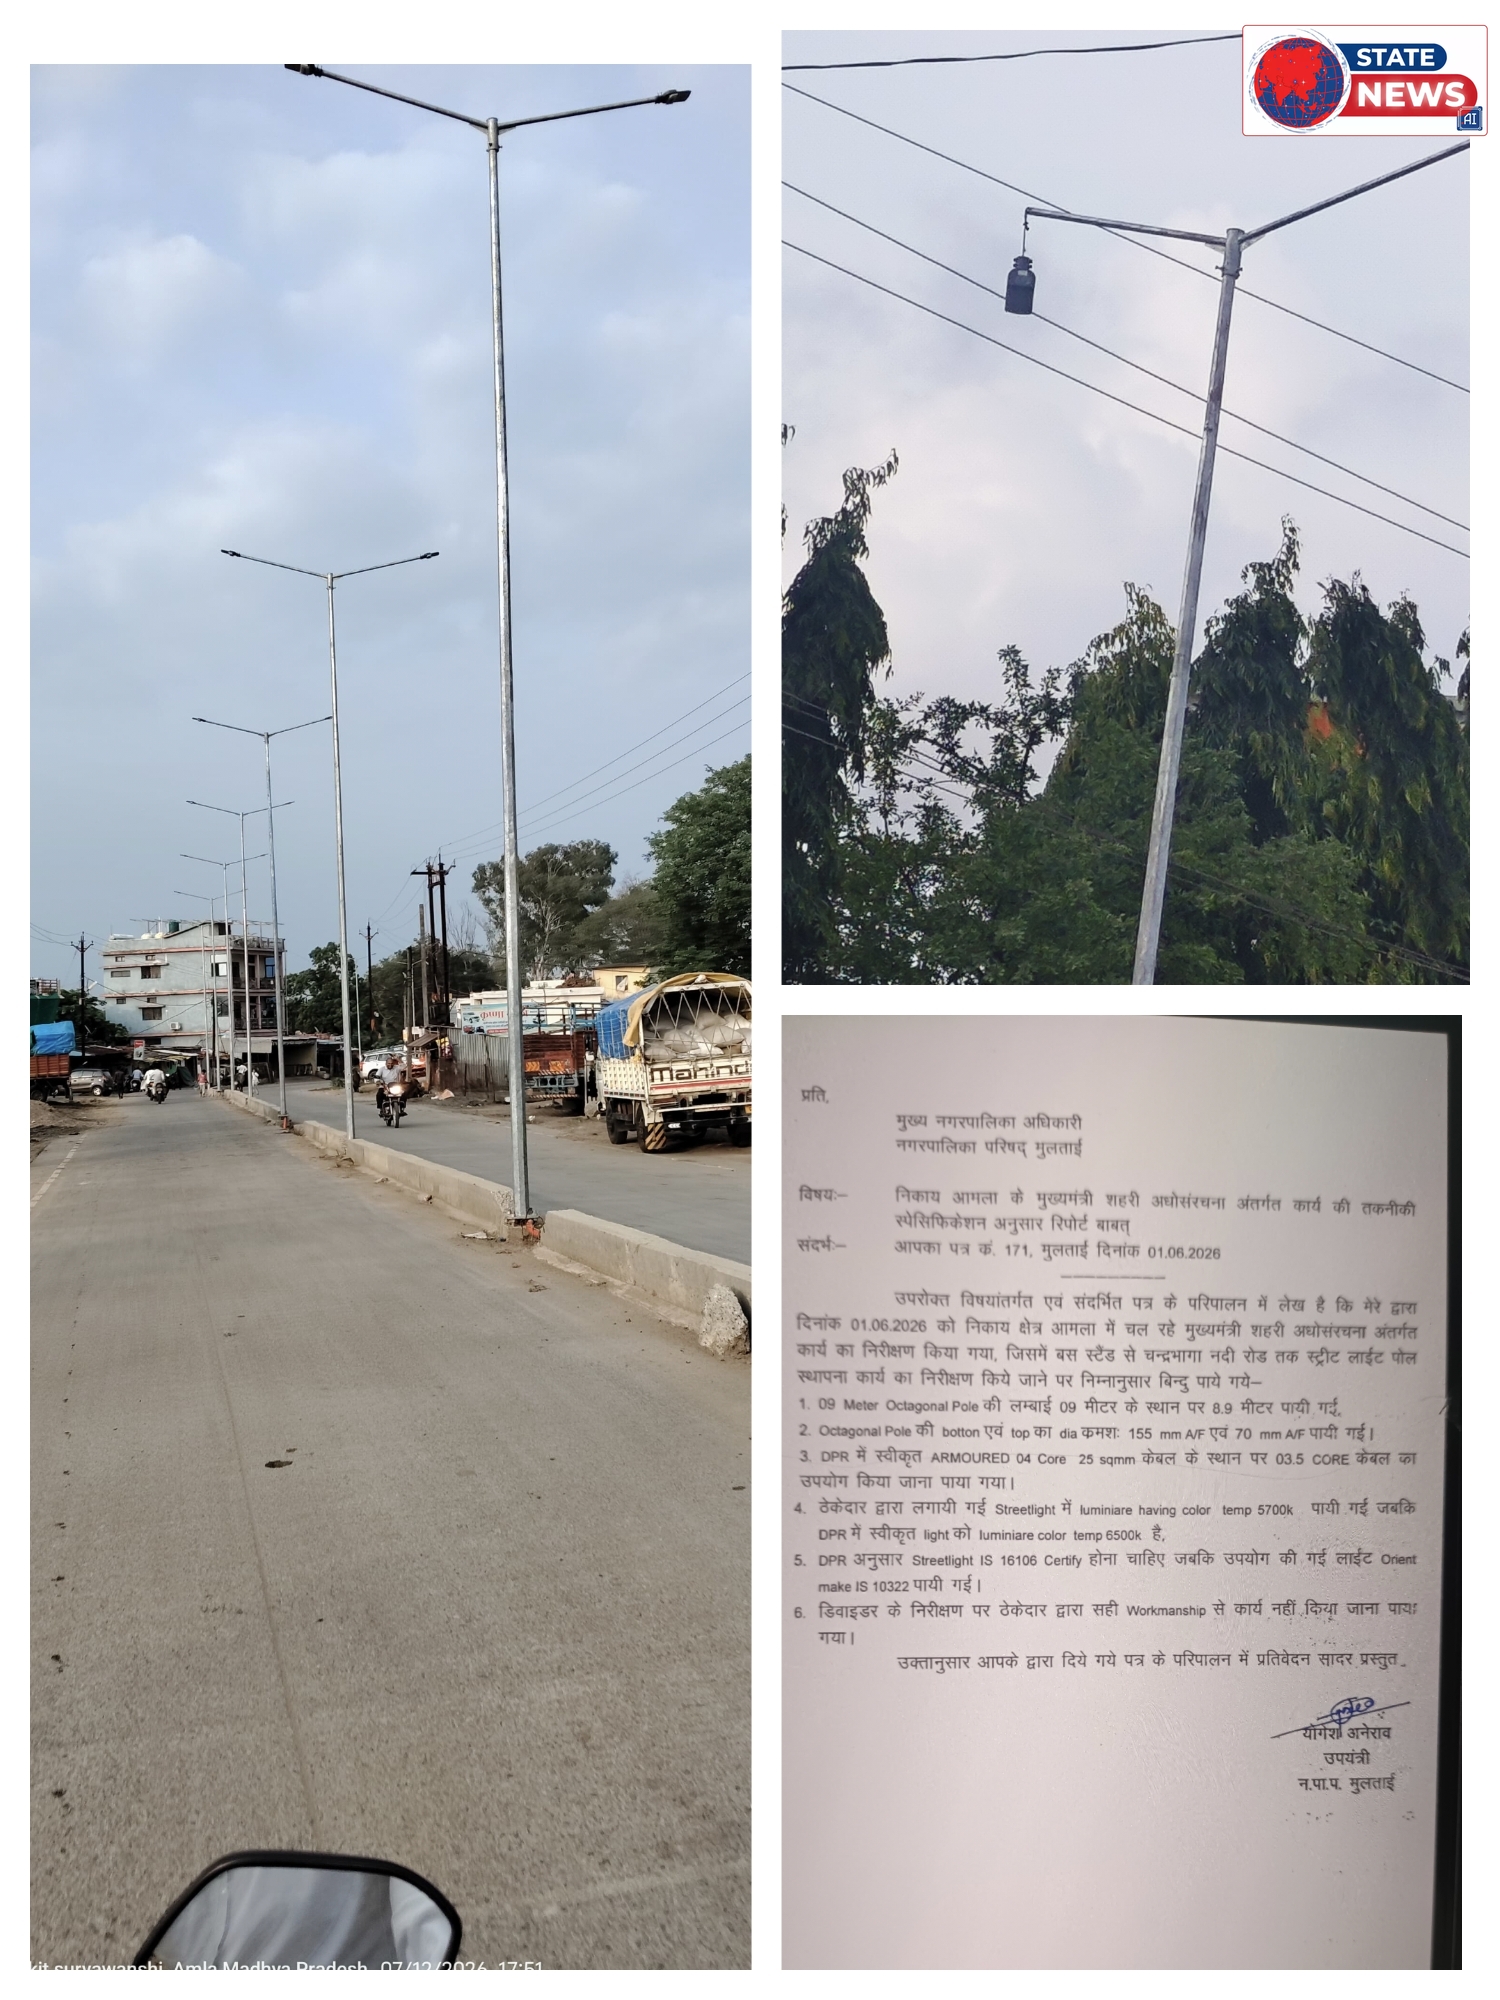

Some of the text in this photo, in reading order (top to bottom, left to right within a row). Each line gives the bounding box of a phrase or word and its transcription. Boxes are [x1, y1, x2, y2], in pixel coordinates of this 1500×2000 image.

[895, 1111, 1083, 1132] मुख्य नगरपालिका अधिकारी
[895, 1136, 1083, 1160] नगरपालिका परिषद् मुलताई
[894, 1240, 942, 1255] आपका
[949, 1242, 970, 1256] पत्र
[1005, 1243, 1033, 1258] 171,
[1040, 1239, 1089, 1262] मुलताई
[1096, 1240, 1141, 1259] दिनांक
[1147, 1246, 1221, 1260] 01.06.2026
[798, 1397, 811, 1411] 1.
[818, 1397, 836, 1411] 09
[843, 1398, 879, 1412] Meter
[885, 1399, 949, 1415] Octagonal
[951, 1400, 980, 1413] Pole
[982, 1394, 1002, 1413] की
[1008, 1394, 1053, 1416] लम्बाई
[1059, 1401, 1077, 1414] 09
[1083, 1396, 1118, 1414] मीटर
[1123, 1396, 1139, 1415] के
[1144, 1401, 1181, 1415] स्थान
[1186, 1401, 1206, 1415] पर
[1212, 1401, 1233, 1415] 8.9
[1239, 1397, 1274, 1415] मीटर
[1280, 1397, 1311, 1415] पायी
[798, 1423, 812, 1437] 2.
[818, 1424, 882, 1440] Octagonal
[884, 1425, 912, 1438] Pole
[914, 1419, 935, 1438] की
[942, 1425, 981, 1439] botton
[983, 1421, 1004, 1441] एवं
[1010, 1426, 1031, 1442] top
[1033, 1425, 1053, 1439] का
[1059, 1427, 1078, 1440] dia
[1128, 1427, 1153, 1440] 155
[1159, 1430, 1182, 1440] mm
[1184, 1428, 1206, 1441] A/F
[1208, 1426, 1230, 1443] एवं
[1234, 1427, 1253, 1440] 70
[1259, 1430, 1282, 1440] mm
[1284, 1428, 1306, 1440] A/F
[1308, 1423, 1339, 1440] पायी
[799, 1444, 1418, 1469] 3. DPR में स्वीकृत ARMOURED 04 Core 25 sqmm केबल के स्थान पर 03.5 CORE केबल का
[793, 1496, 1417, 1519] 4. ठेकेदार द्वारा लगायी गई Streetlight में luminiare having color temp 5700k पायी गई जबकि
[818, 1529, 847, 1541] DPR
[850, 1522, 862, 1541] में
[868, 1522, 917, 1546] स्वीकृत
[923, 1529, 950, 1544] light
[952, 1522, 972, 1541] को
[979, 1529, 1035, 1541] luminiare
[1037, 1529, 1068, 1541] color
[1073, 1529, 1103, 1544] temp
[1105, 1529, 1143, 1541] 6500k
[793, 1546, 1418, 1572] 5. DPR अनुसार Streetlight IS 16106 Certify होना चाहिए जबकि उपयोग की गई लाईट Orient
[793, 1606, 806, 1619] 6.
[818, 1600, 880, 1621] डिवाइडर
[886, 1600, 903, 1618] के
[909, 1600, 965, 1618] निरीक्षण
[971, 1604, 992, 1618] पर
[998, 1599, 1048, 1618] ठेकेदार
[1054, 1603, 1085, 1619] द्वारा
[1090, 1599, 1120, 1618] सही
[1126, 1604, 1207, 1619] Workmanship
[1211, 1598, 1227, 1616] से
[1232, 1597, 1264, 1616] कार्य
[1271, 1598, 1297, 1617] नहीं
[1304, 1598, 1339, 1616] किया
[1345, 1602, 1382, 1616] जाना
[896, 1648, 1399, 1675] उक्तानुसार आपके द्वारा दिये गये पत्र के परिपालन में प्रतिवेदन सादर प्रस्तुत
[1346, 1722, 1393, 1740] अनेराव
[1322, 1747, 1371, 1765] उपयंत्री
[1348, 1772, 1396, 1795] मुलताई
